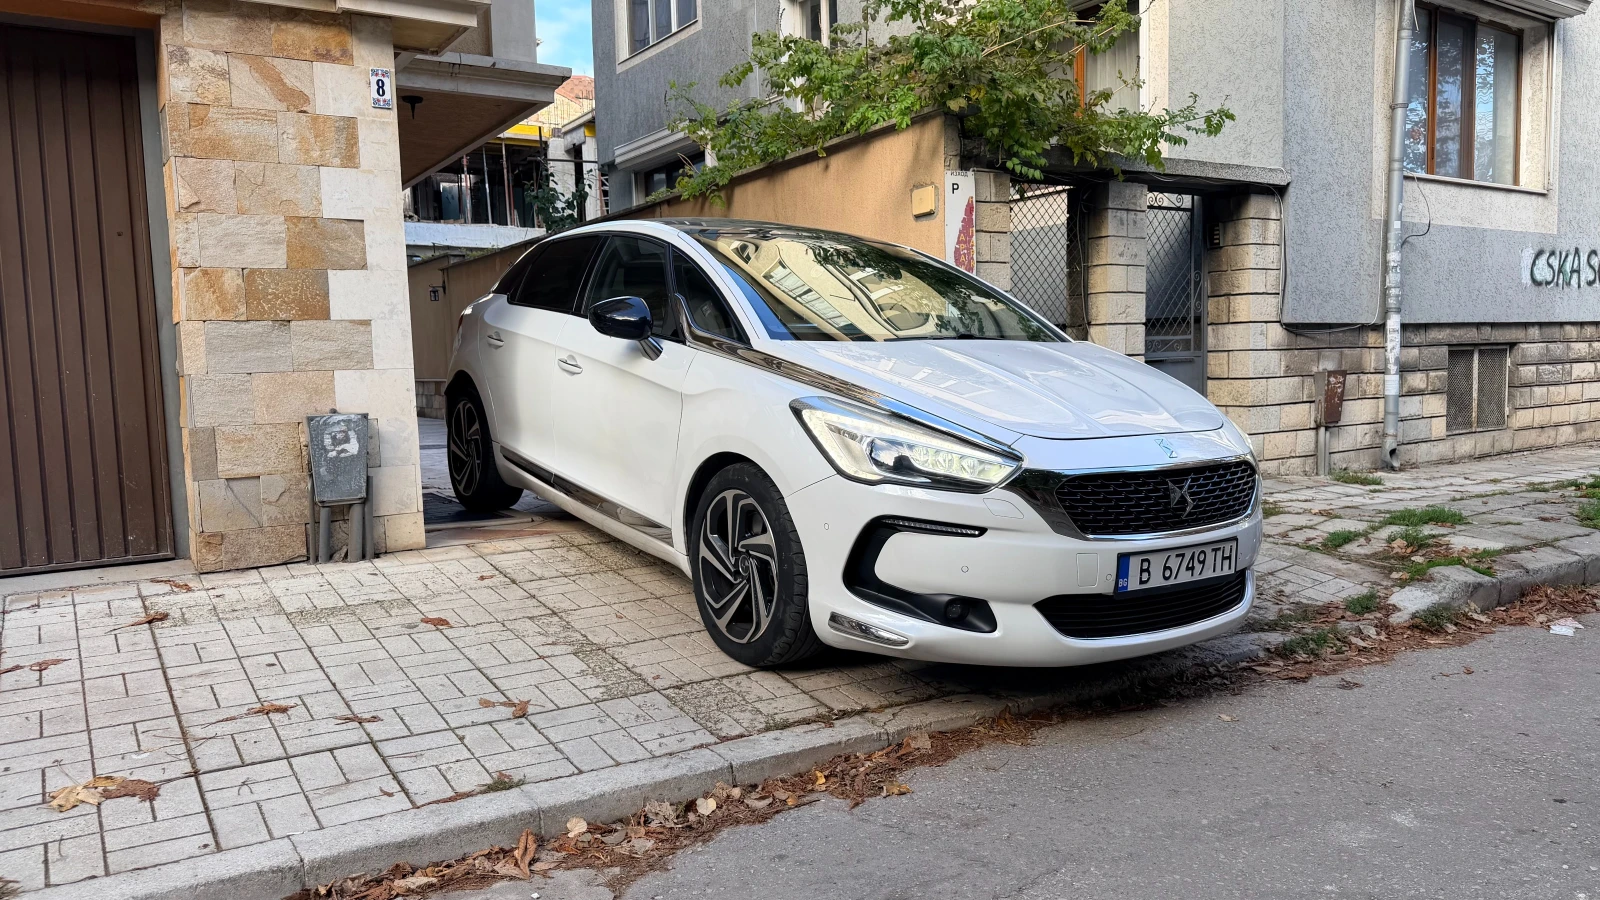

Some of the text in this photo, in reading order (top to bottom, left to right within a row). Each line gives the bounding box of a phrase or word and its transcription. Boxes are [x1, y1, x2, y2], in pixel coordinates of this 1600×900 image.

[376, 78, 386, 97] 8
[1586, 249, 1600, 286] S
[1139, 545, 1233, 585] B 6749 TH
[1118, 578, 1128, 588] BG
